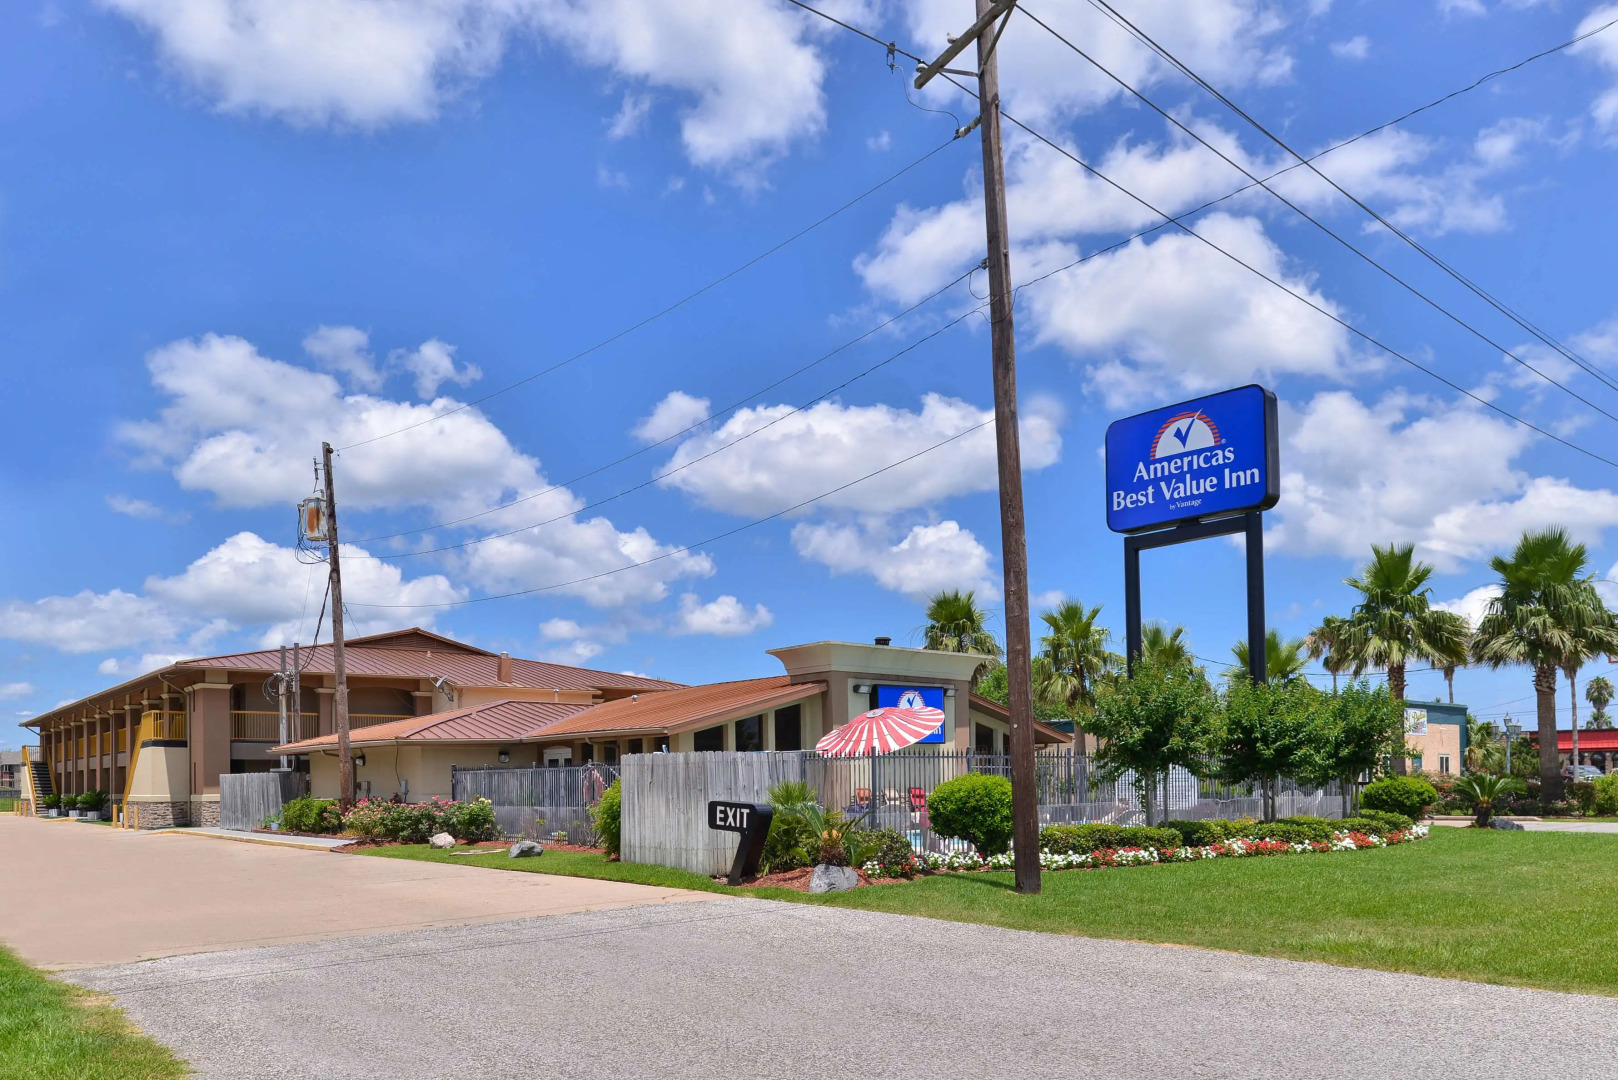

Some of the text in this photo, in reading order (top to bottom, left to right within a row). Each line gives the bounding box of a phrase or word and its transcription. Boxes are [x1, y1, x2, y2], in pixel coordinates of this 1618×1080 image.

[1133, 447, 1234, 482] Americas
[1113, 468, 1259, 511] Best Value Inn
[1176, 499, 1202, 508] Vantage
[716, 805, 750, 829] EXIT
